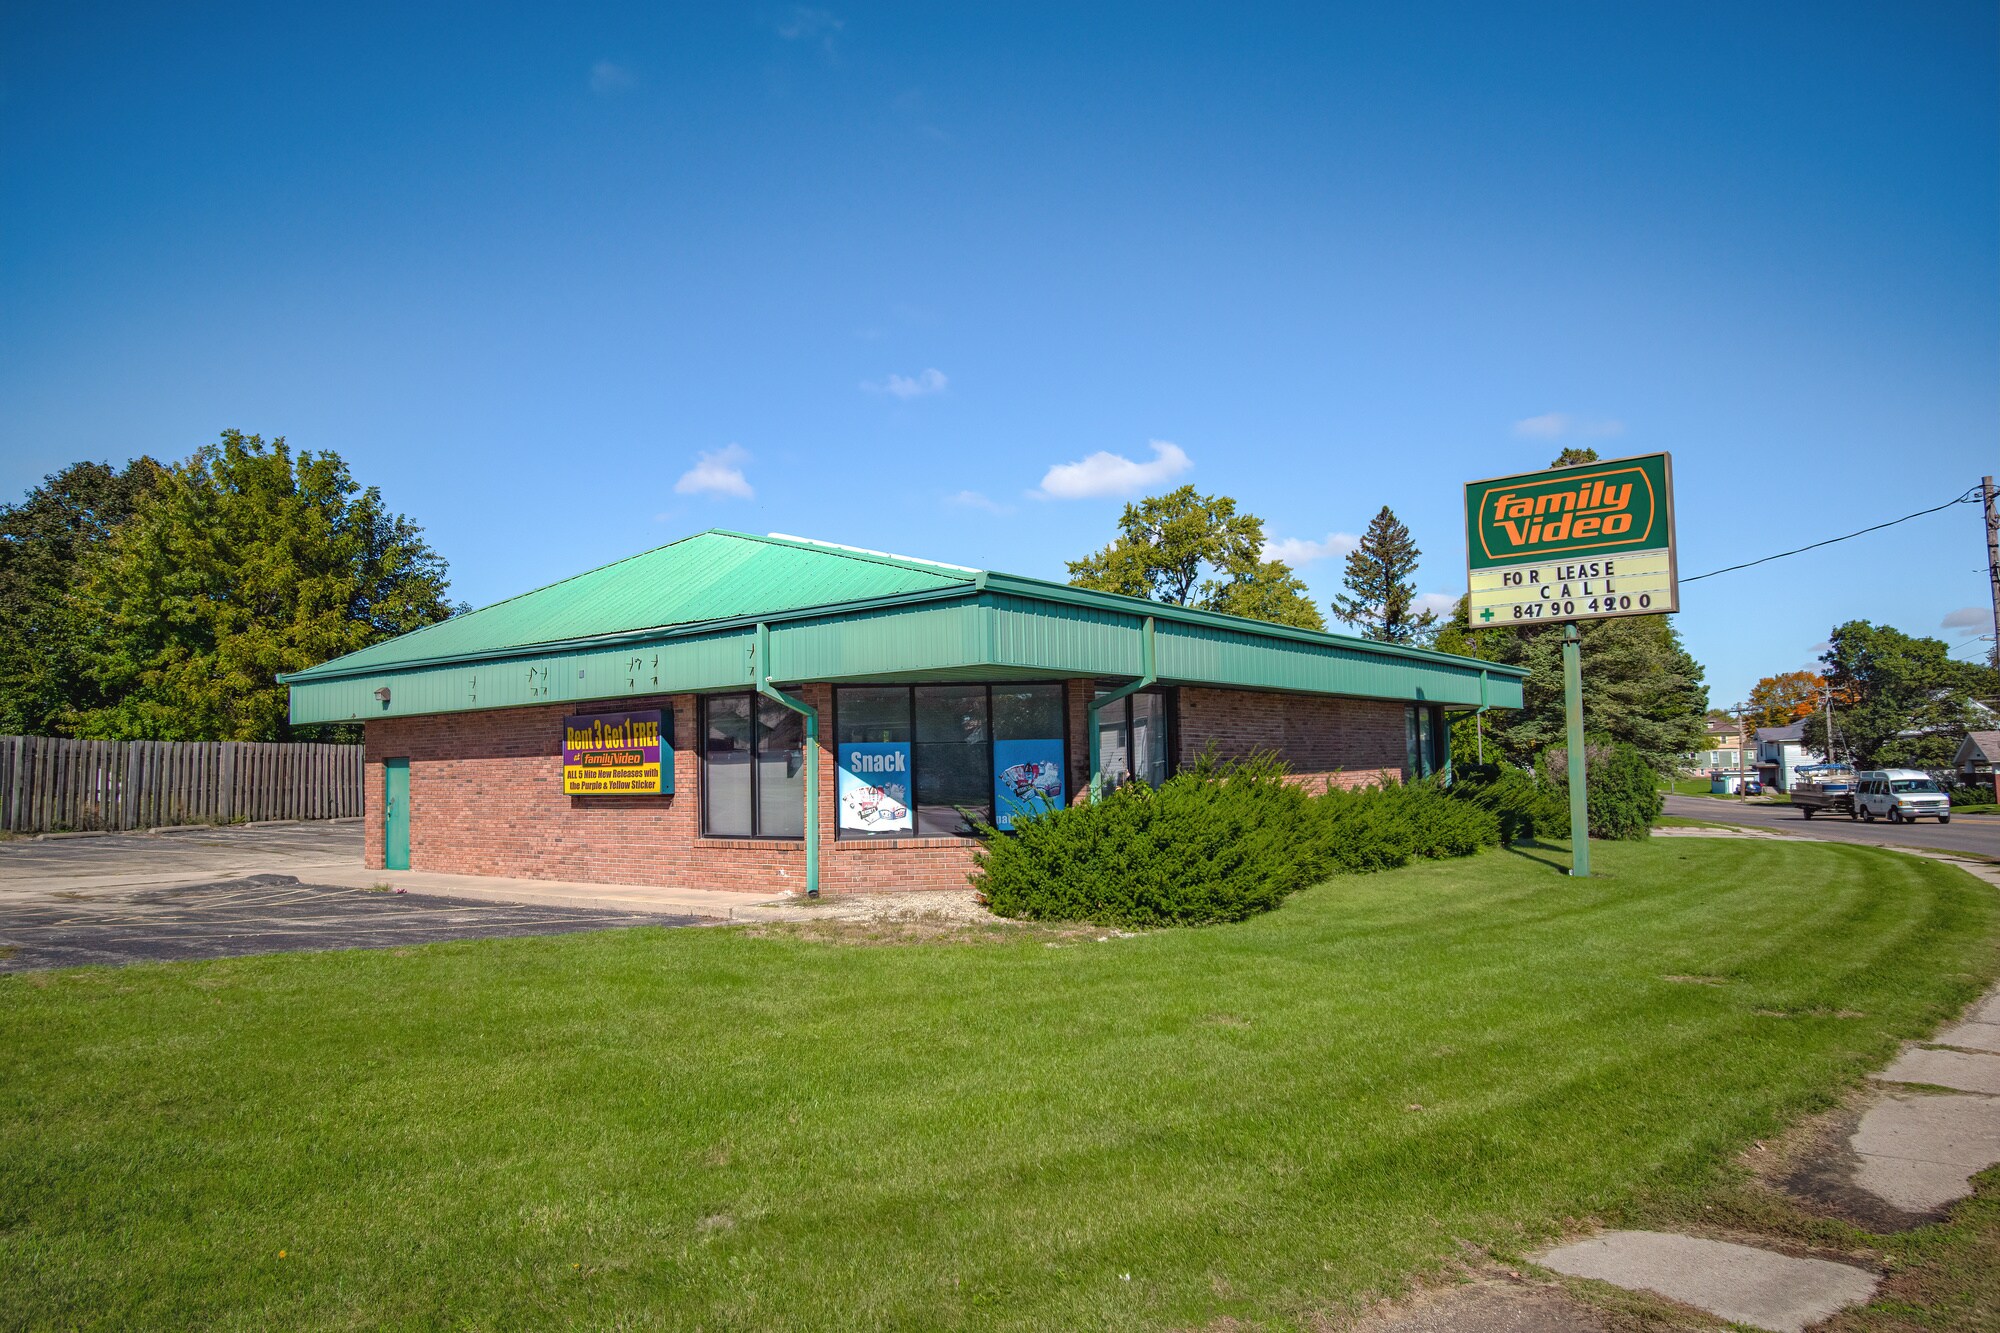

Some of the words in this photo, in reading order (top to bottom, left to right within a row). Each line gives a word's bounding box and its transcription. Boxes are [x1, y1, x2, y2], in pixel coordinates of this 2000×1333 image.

[1493, 480, 1633, 520] family
[1493, 512, 1633, 546] Video
[1503, 570, 1540, 586] FOR
[1557, 561, 1615, 581] LEASE
[1540, 579, 1616, 599] CALL
[567, 727, 593, 750] Rent
[594, 719, 602, 749] 3
[604, 724, 625, 749] Get
[625, 717, 632, 748] 1
[633, 721, 659, 748] FREE
[578, 770, 583, 778] 5
[584, 769, 597, 778] Nite
[598, 769, 612, 778] New
[613, 768, 643, 778] Releases
[644, 767, 659, 777] with
[851, 751, 906, 773] Snack
[570, 782, 580, 790] the
[581, 781, 603, 790] Purple
[609, 780, 631, 790] Yellow
[632, 780, 656, 789] Sticker
